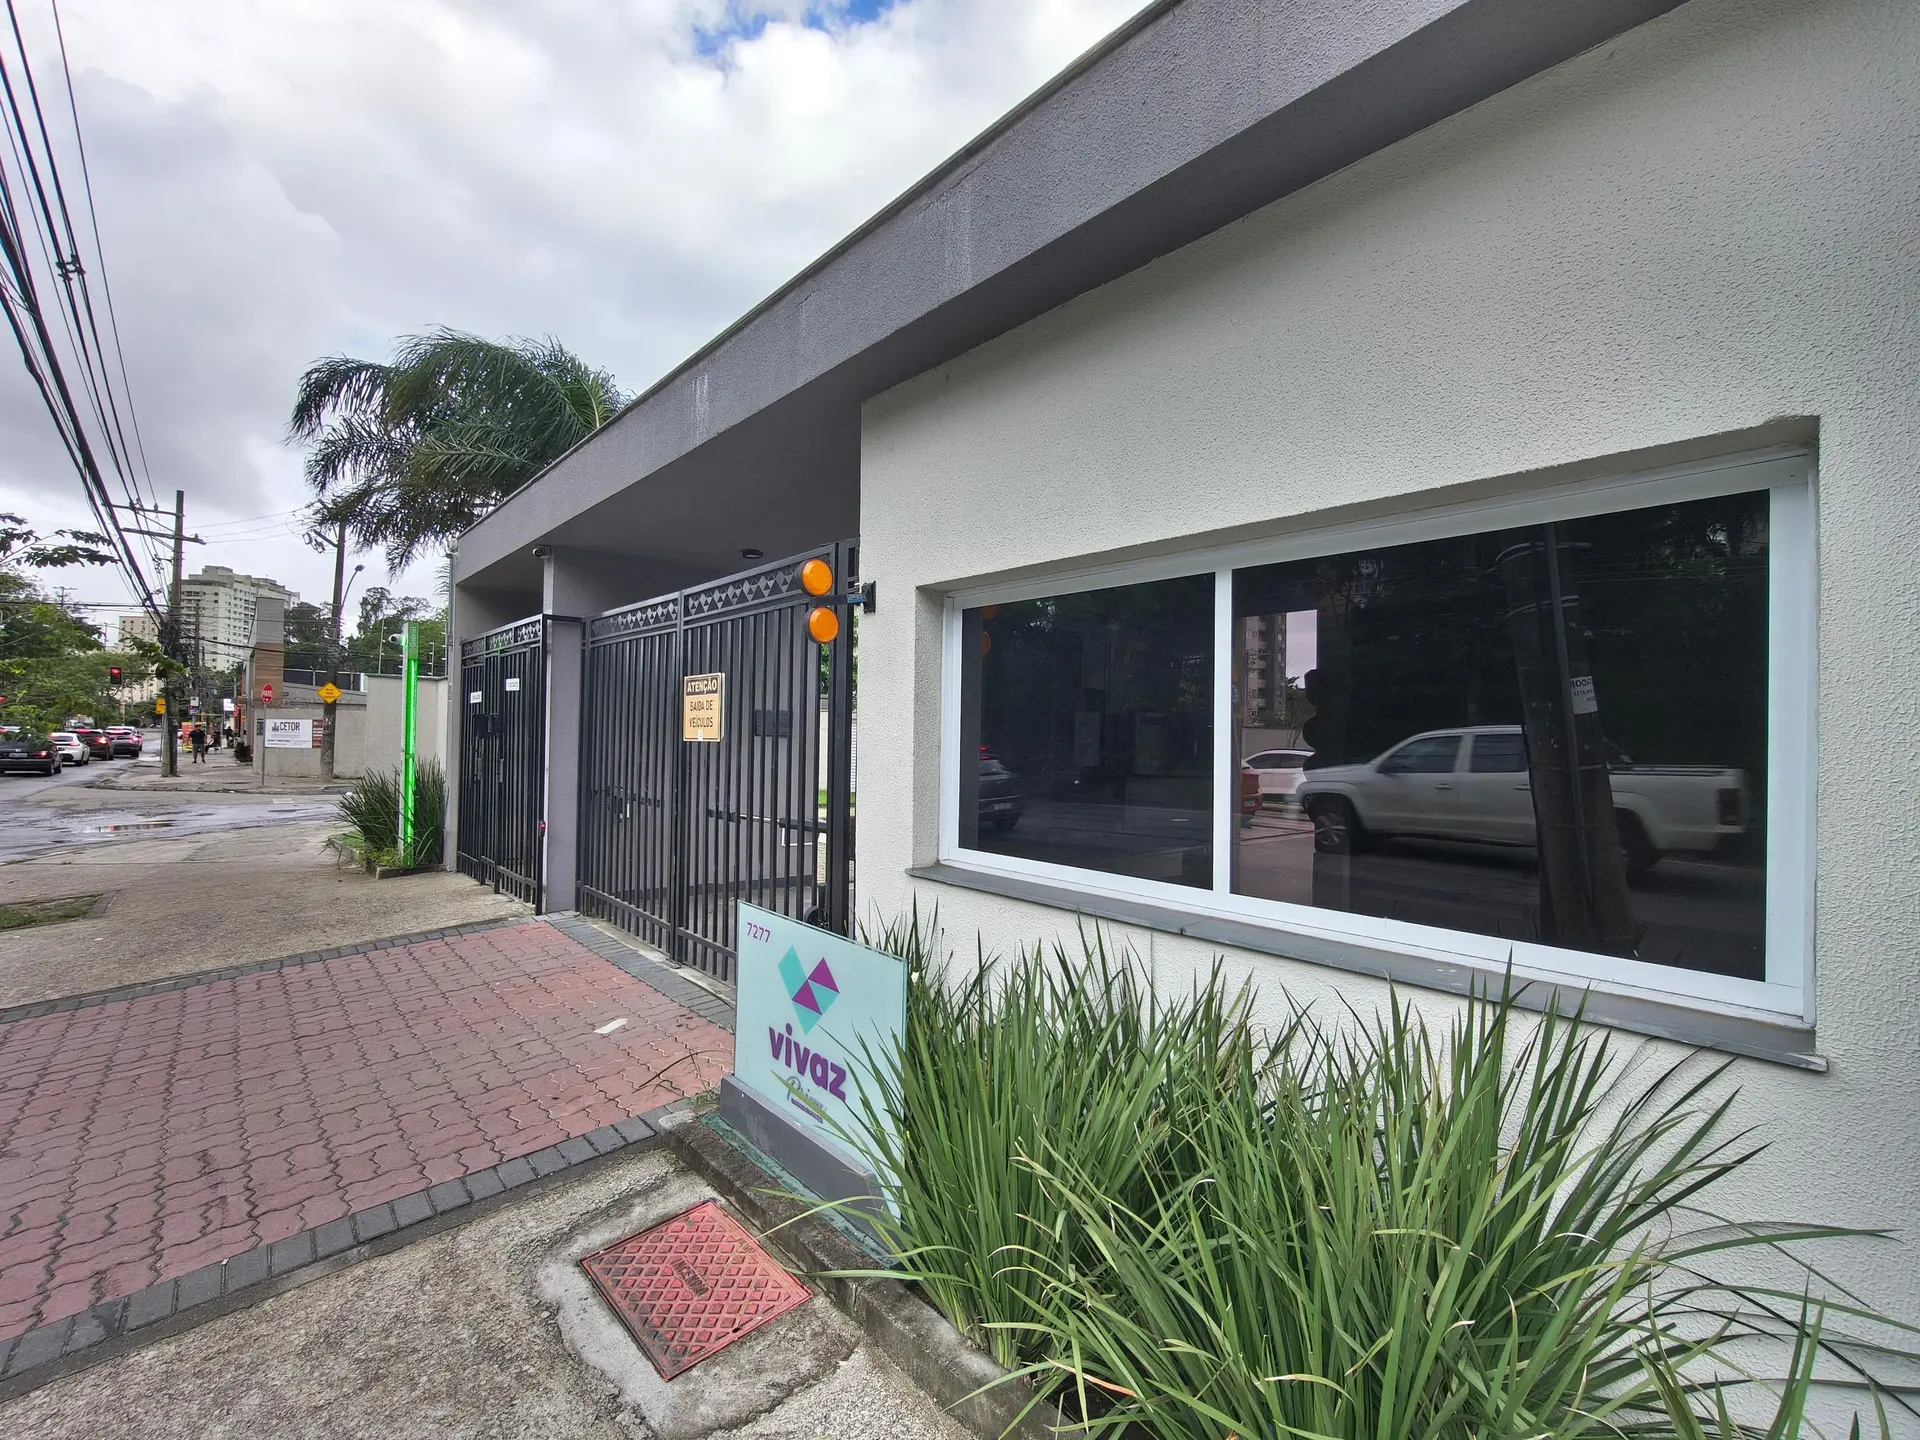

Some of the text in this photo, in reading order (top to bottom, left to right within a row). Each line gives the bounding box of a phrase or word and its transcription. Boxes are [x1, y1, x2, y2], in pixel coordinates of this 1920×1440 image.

[687, 678, 717, 694] ATENÇÃO
[690, 698, 714, 711] SAÍDA DE
[280, 721, 300, 731] CETOR
[689, 715, 714, 728] VEÍCULOS
[747, 922, 770, 943] 7277
[769, 1022, 846, 1101] vivaz
